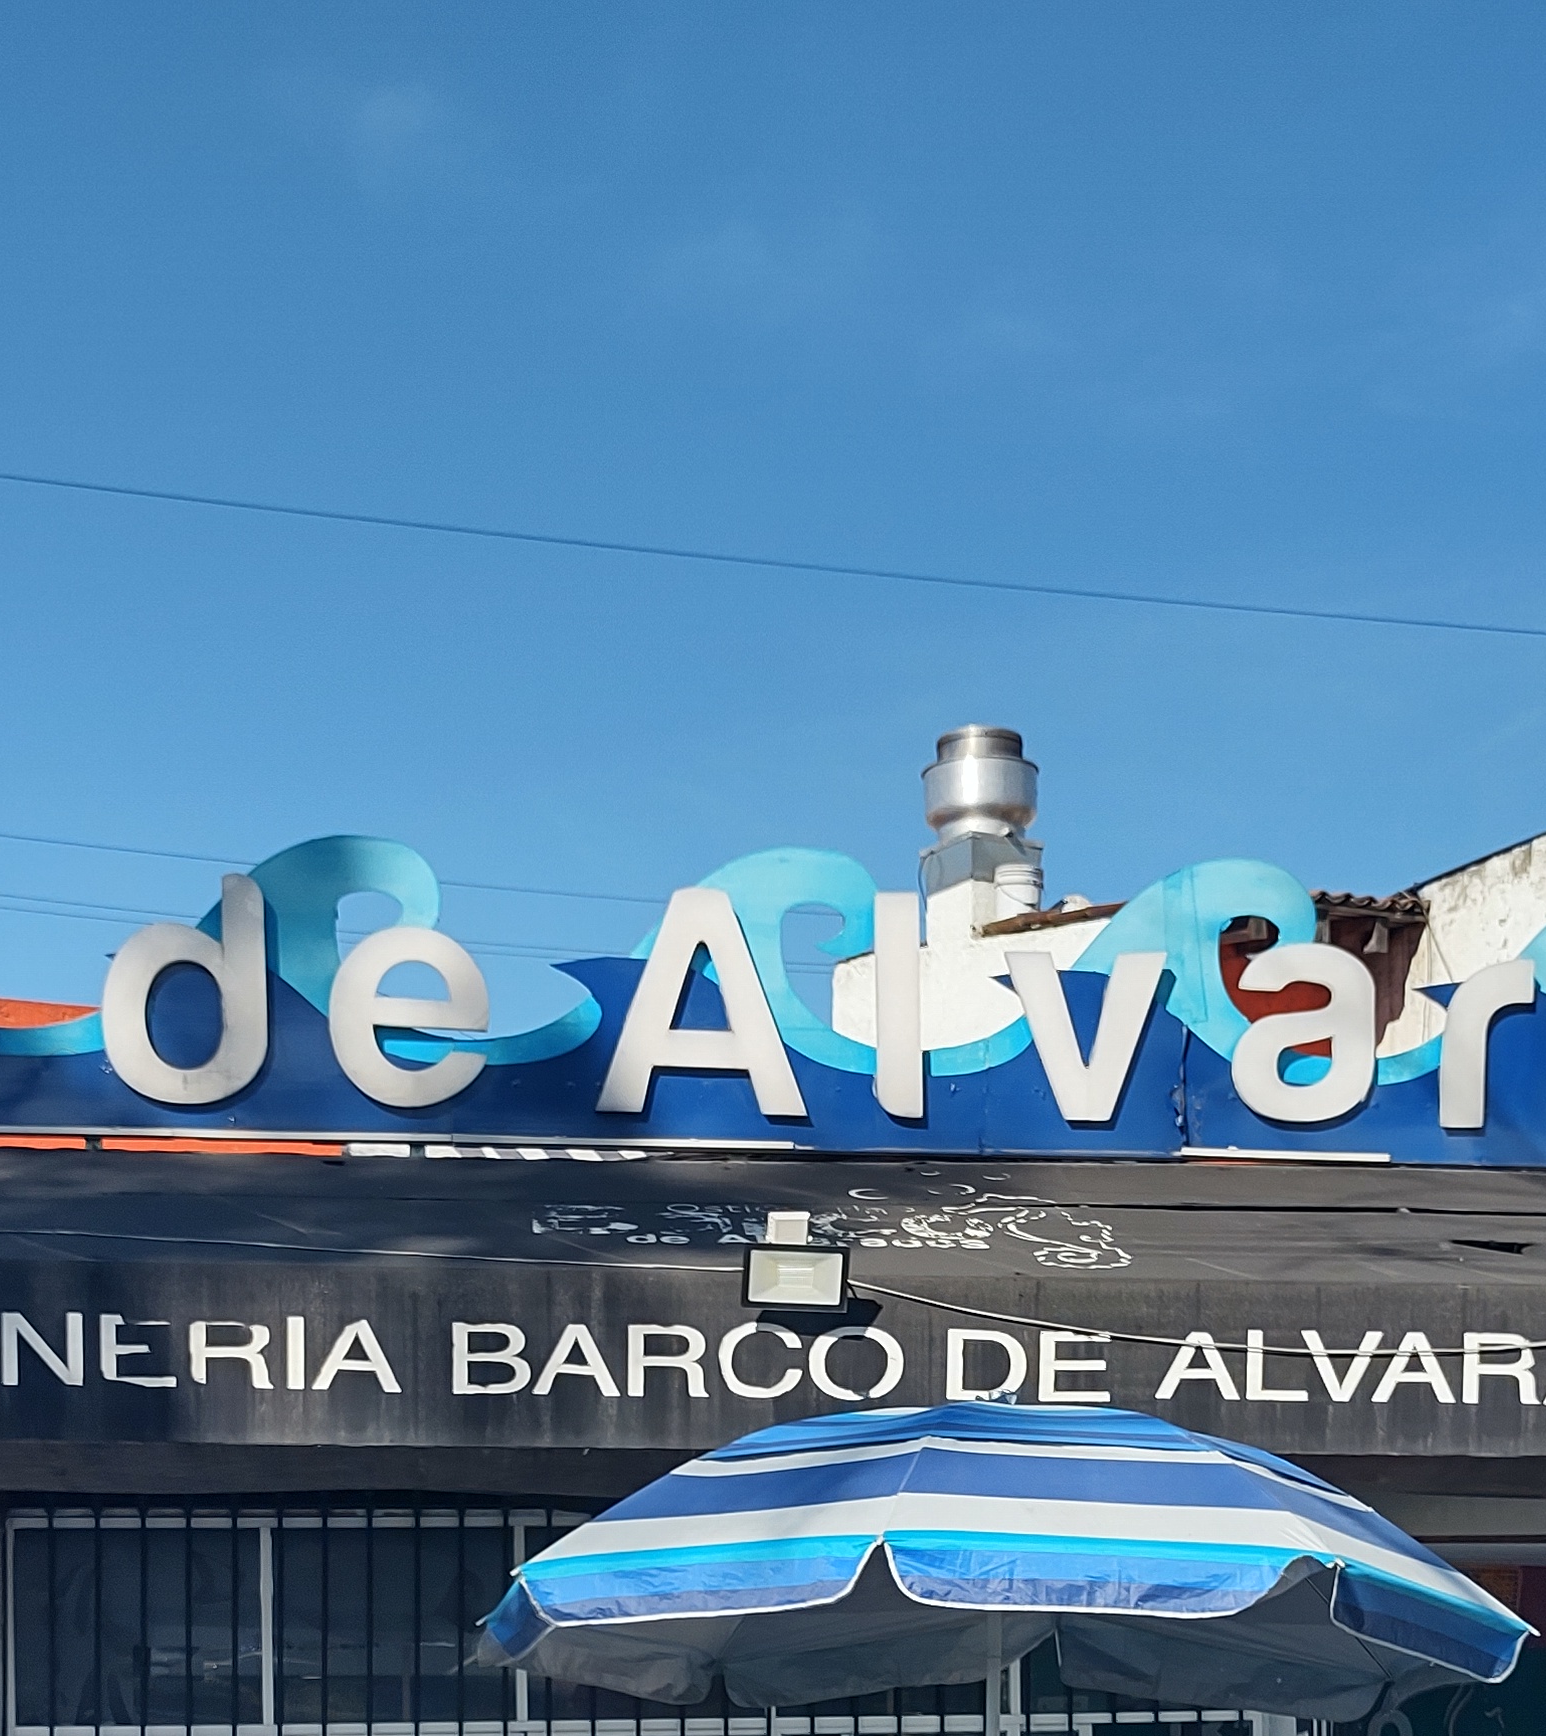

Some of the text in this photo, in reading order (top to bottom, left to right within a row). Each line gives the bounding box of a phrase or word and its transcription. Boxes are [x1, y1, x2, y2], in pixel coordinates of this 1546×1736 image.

[101, 873, 490, 1107] de
[452, 1322, 904, 1400] BARCO
[946, 1328, 1111, 1402] DE
